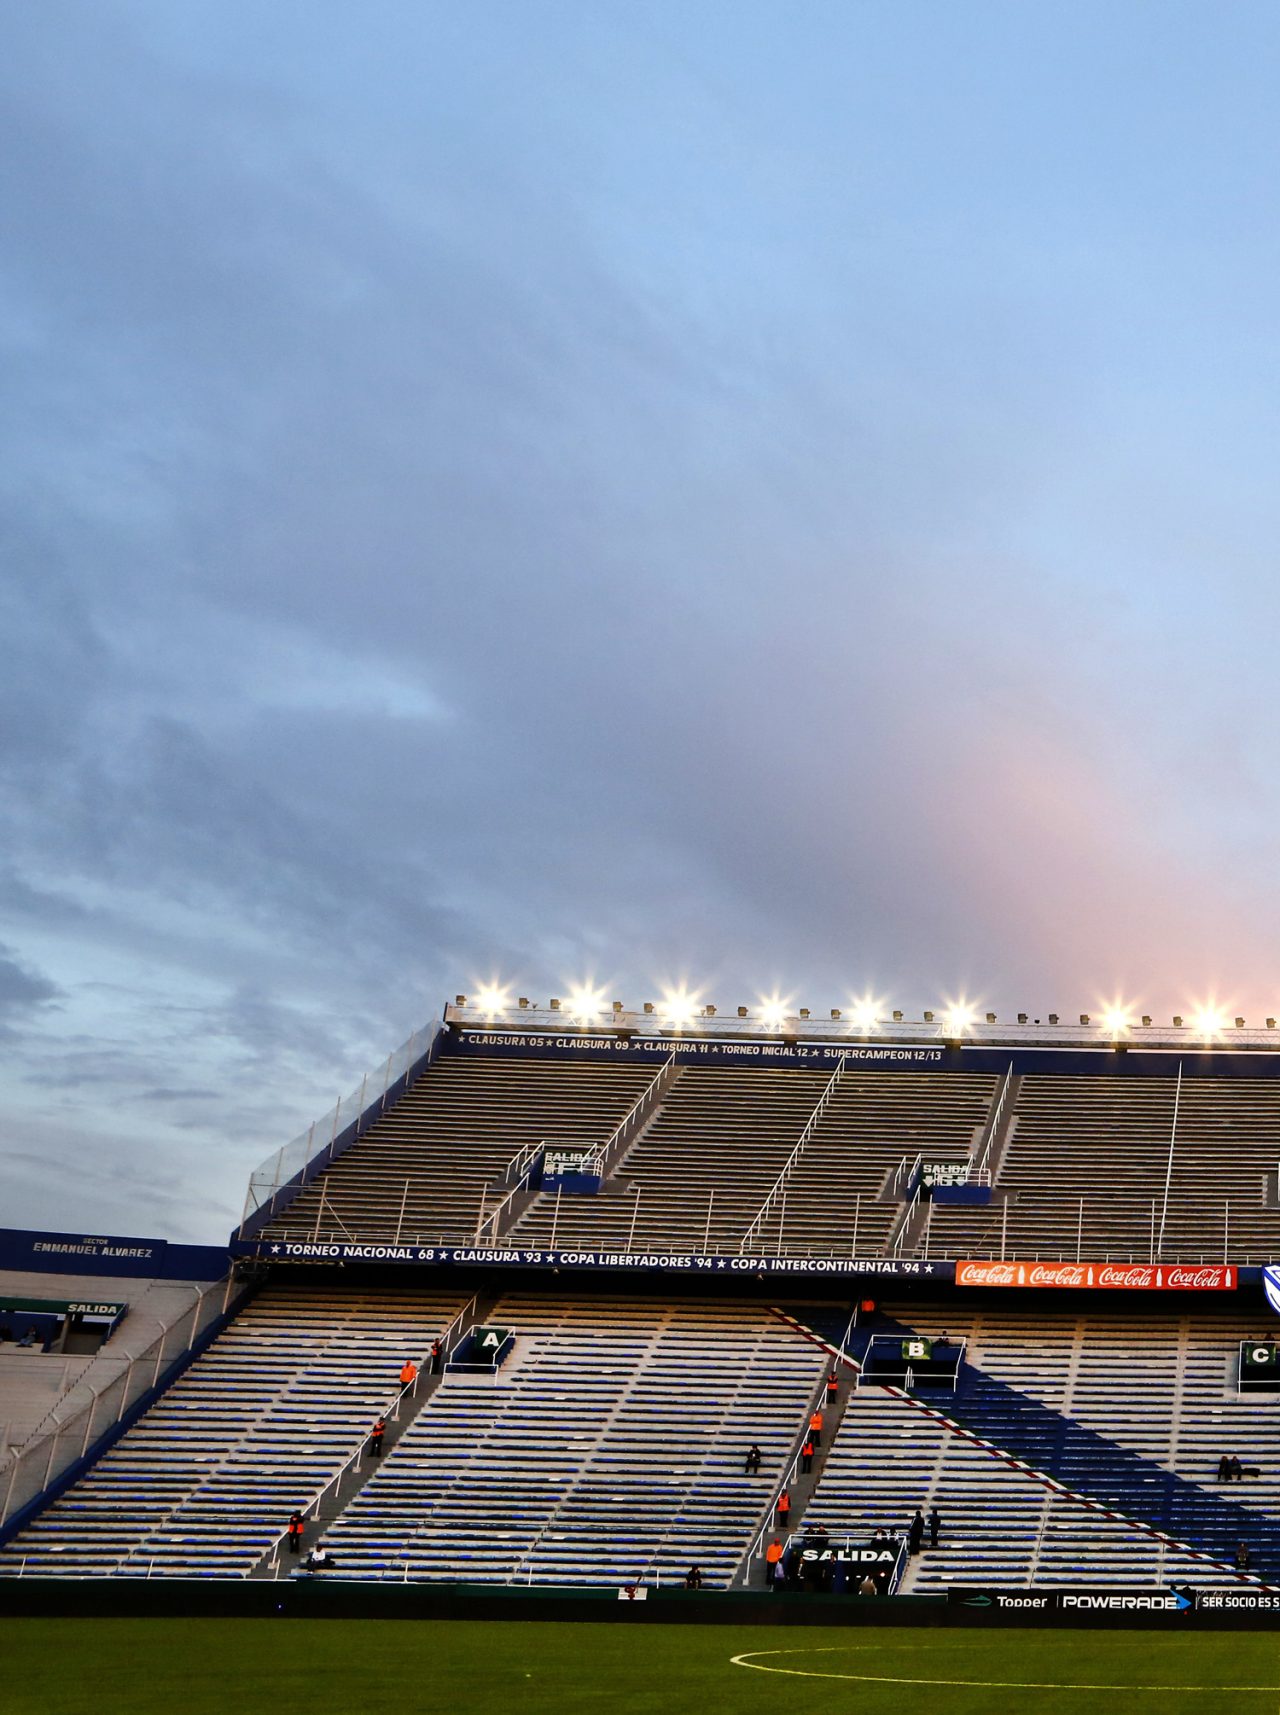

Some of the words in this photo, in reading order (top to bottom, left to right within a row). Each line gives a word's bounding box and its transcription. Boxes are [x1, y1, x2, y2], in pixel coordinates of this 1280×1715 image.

[468, 1035, 526, 1047] CLAUSURA
[556, 1038, 611, 1050] CLAUSURA
[643, 1042, 697, 1053] CLAUSURA
[721, 1045, 760, 1055] TORNEO
[762, 1046, 795, 1056] INICIAL
[823, 1048, 912, 1060] SUPERCAMPEON
[914, 1051, 942, 1061] 12/13
[33, 1242, 98, 1256] EMMANUEL
[101, 1246, 153, 1258] ALVAREZ
[285, 1244, 340, 1257] TORNEO
[343, 1246, 413, 1260] NACIONAL
[418, 1249, 434, 1260] 68
[453, 1250, 520, 1262] CLAUSURA
[523, 1252, 542, 1263] '93
[560, 1253, 596, 1265] COPA
[598, 1254, 691, 1267] LIBERTADORES
[694, 1257, 712, 1268] '94
[730, 1258, 768, 1270] COPA
[771, 1259, 898, 1273] INTERCONTINENTAL
[901, 1262, 920, 1273] '94
[960, 1264, 1016, 1284] Coca-Cola
[1029, 1265, 1085, 1286] Coca-Cola
[1099, 1266, 1154, 1287] Coca-Cola
[1167, 1267, 1223, 1288] Coca-Cola
[67, 1303, 118, 1314] SALIDA
[482, 1332, 500, 1347] A
[908, 1342, 925, 1357] B
[1252, 1347, 1269, 1363] C
[802, 1549, 895, 1562] SALIDA
[1062, 1596, 1178, 1609] POWERADE
[1202, 1596, 1223, 1608] SER
[1225, 1596, 1256, 1608] SOCIO
[1258, 1596, 1271, 1608] ES
